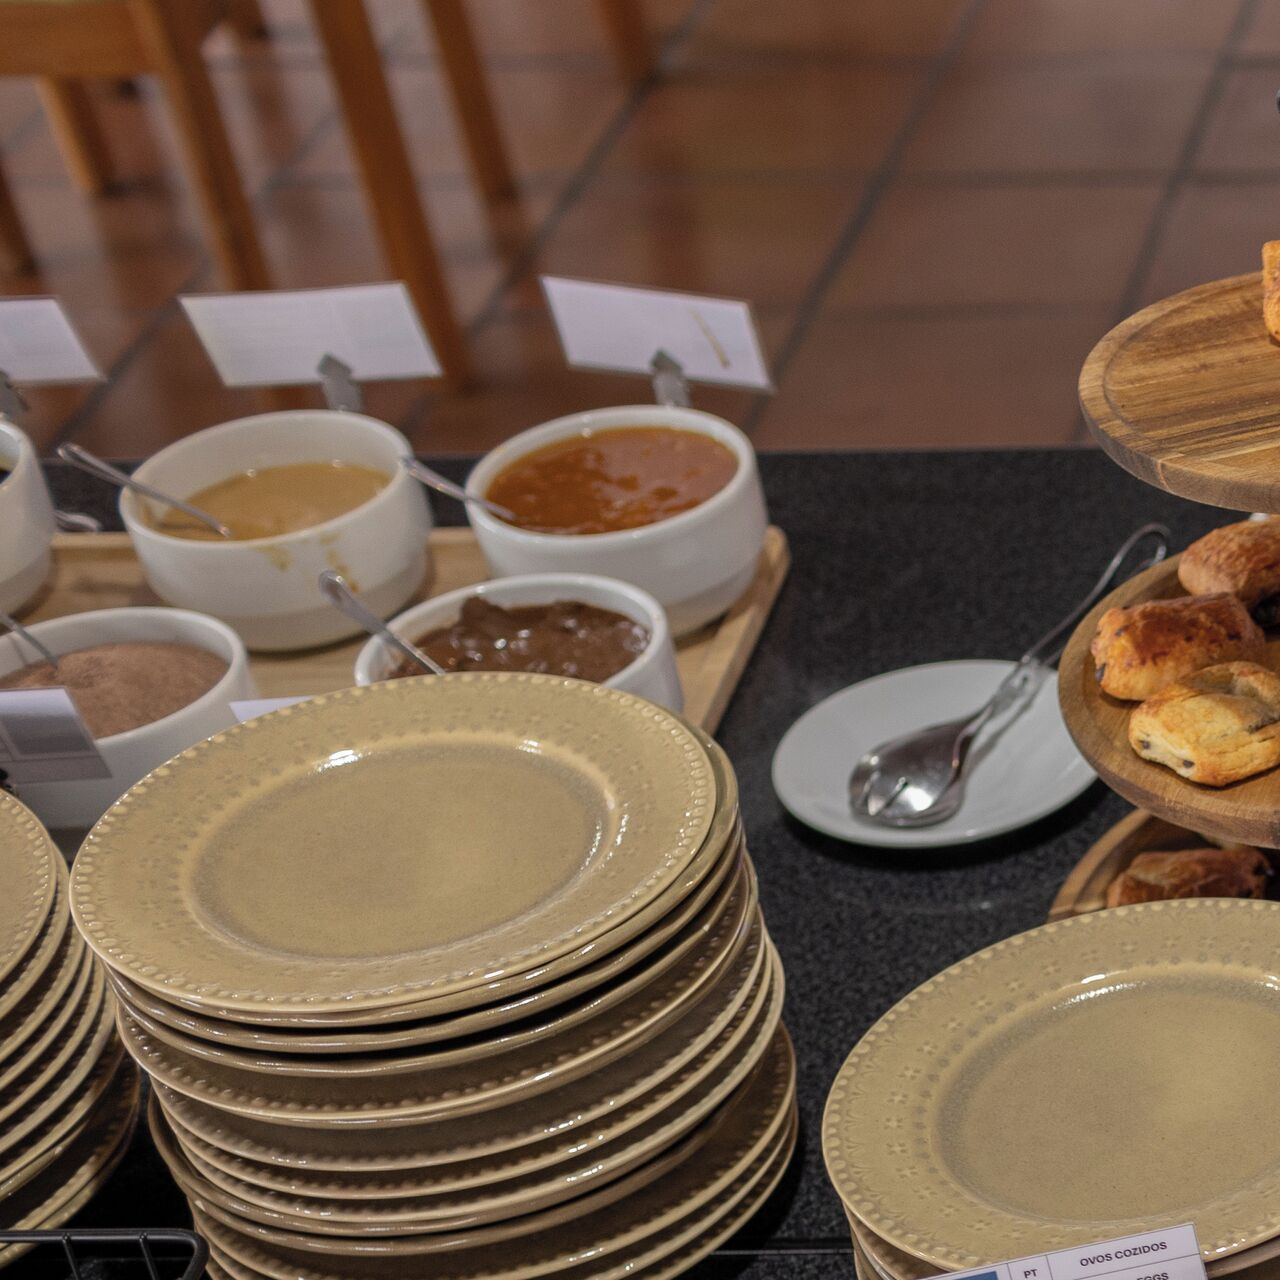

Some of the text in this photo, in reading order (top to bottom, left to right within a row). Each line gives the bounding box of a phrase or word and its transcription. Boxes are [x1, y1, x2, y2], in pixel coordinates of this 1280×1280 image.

[1079, 1241, 1168, 1268] OVOS COZIDOS
[1023, 1268, 1037, 1279] PT
